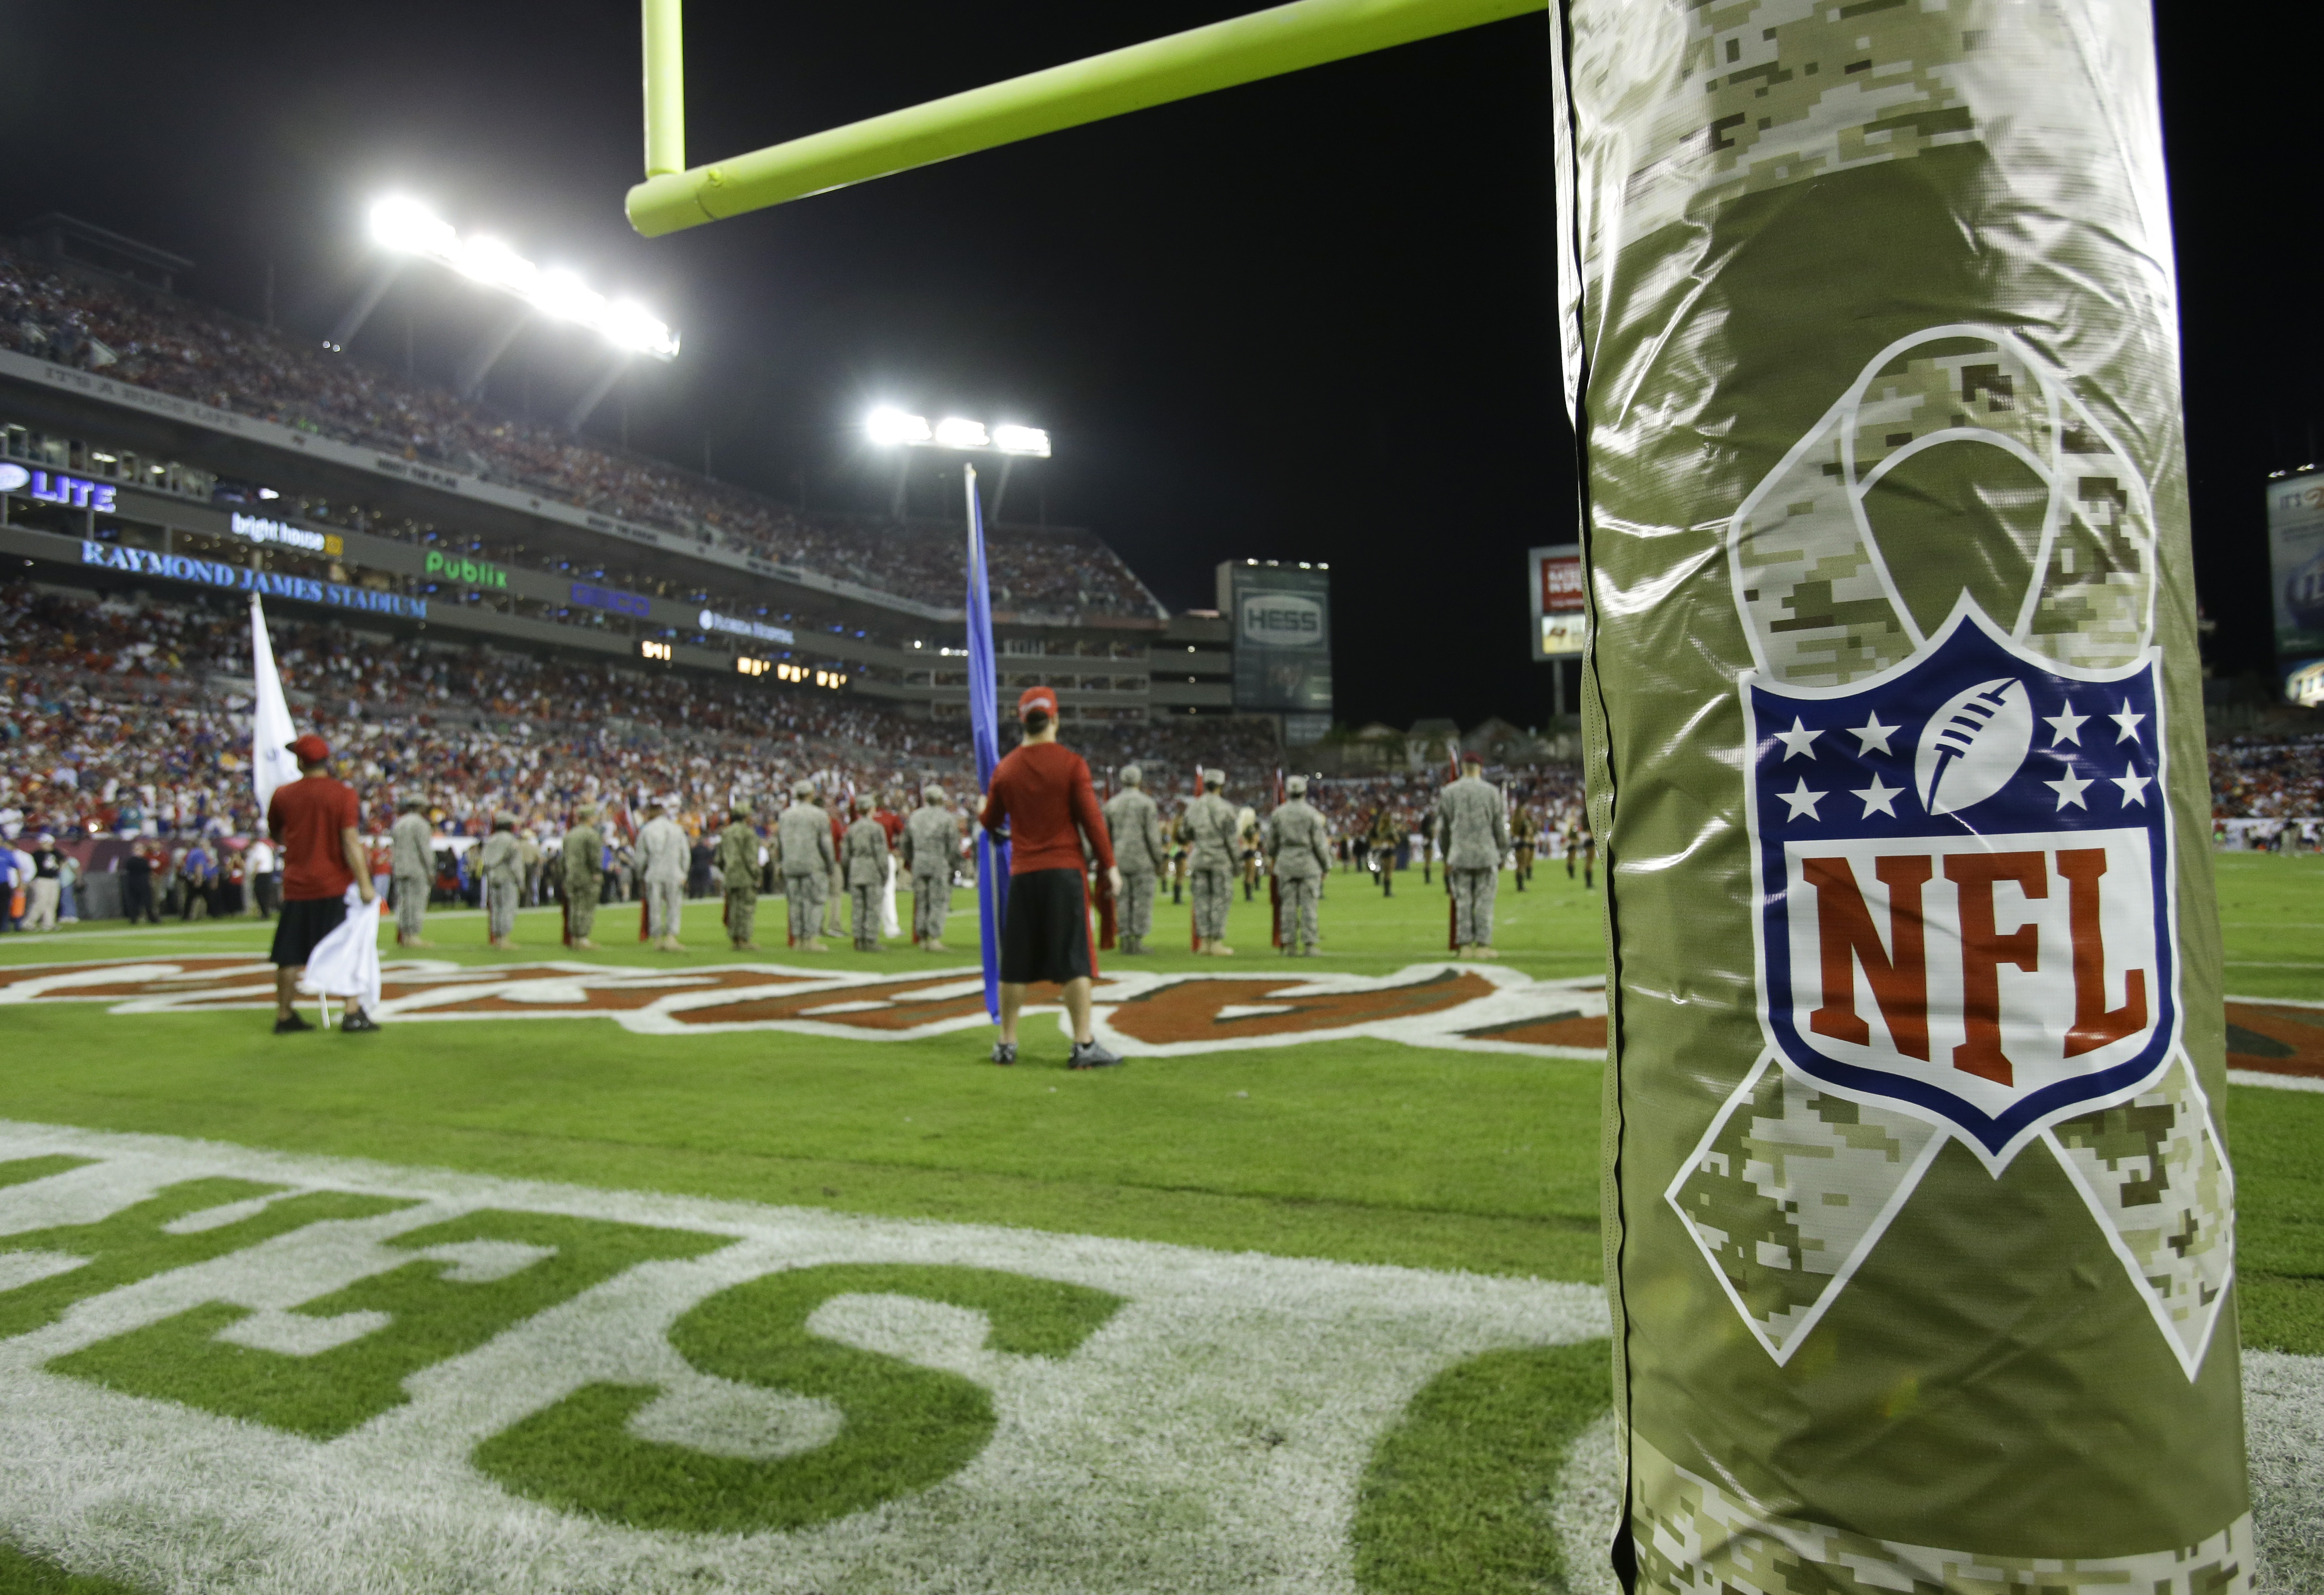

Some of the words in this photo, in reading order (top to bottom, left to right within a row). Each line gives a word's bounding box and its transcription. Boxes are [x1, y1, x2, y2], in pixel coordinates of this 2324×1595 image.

[31, 470, 117, 514] LITE
[232, 511, 279, 543] bright
[279, 522, 325, 551] house
[82, 540, 235, 587] RAYMOND
[239, 568, 323, 603] JAMES
[327, 583, 427, 619] STADIUM
[426, 550, 507, 588] Publix
[1248, 607, 1318, 632] HESS
[1801, 848, 2147, 1088] NFL
